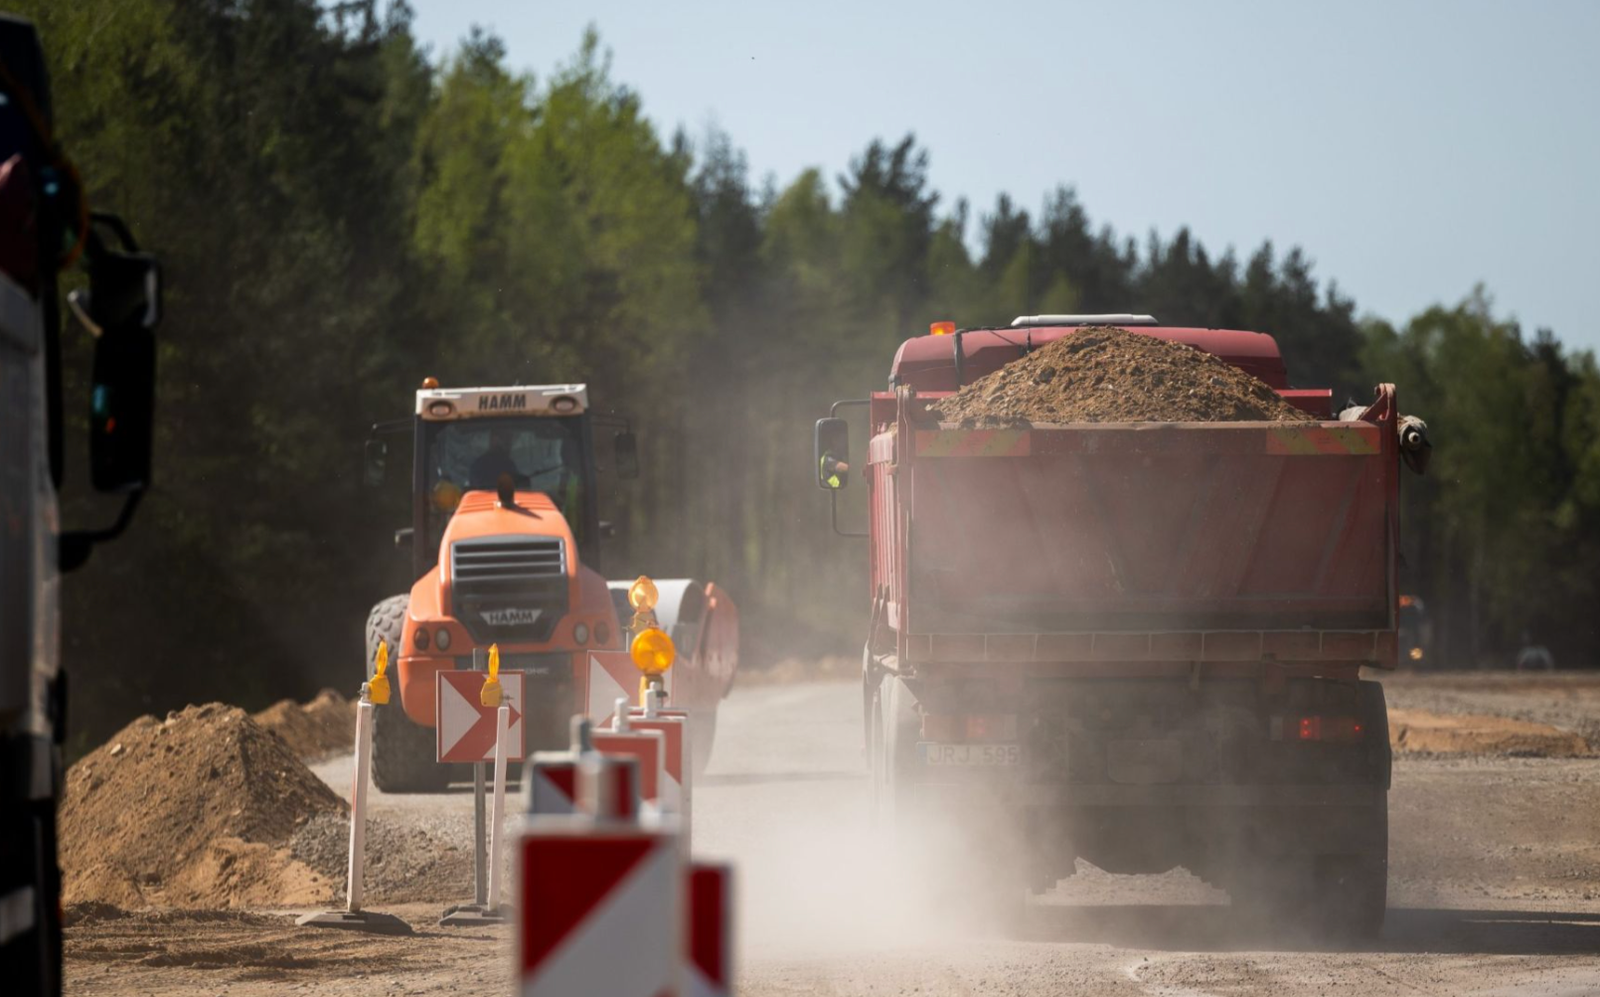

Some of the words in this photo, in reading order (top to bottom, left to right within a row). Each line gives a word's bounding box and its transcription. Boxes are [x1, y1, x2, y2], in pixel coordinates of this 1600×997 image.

[479, 395, 526, 411] HAMM
[488, 610, 533, 623] HAMM
[929, 746, 971, 764] JRJ
